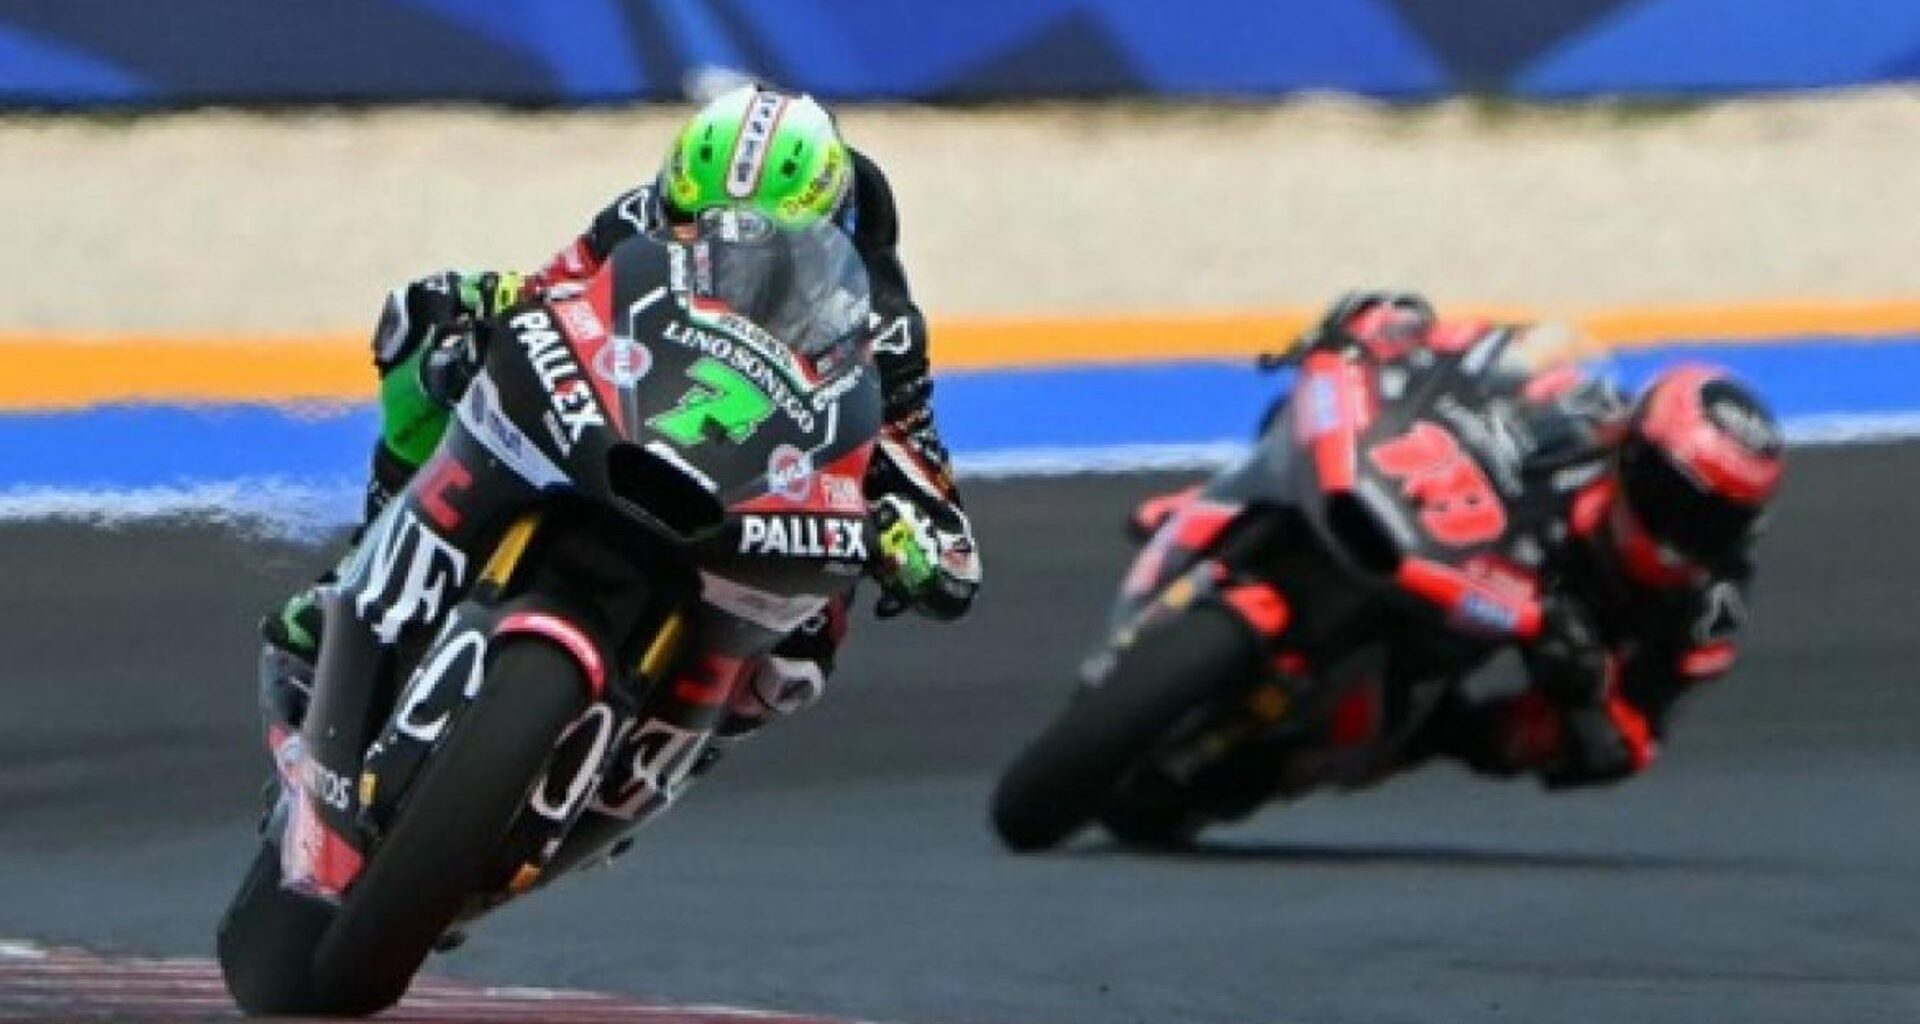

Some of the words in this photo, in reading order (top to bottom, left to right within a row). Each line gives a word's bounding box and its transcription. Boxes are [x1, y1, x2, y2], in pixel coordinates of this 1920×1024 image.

[509, 311, 606, 444] PALLEX
[644, 356, 777, 445] 7
[739, 515, 868, 560] PALLEX
